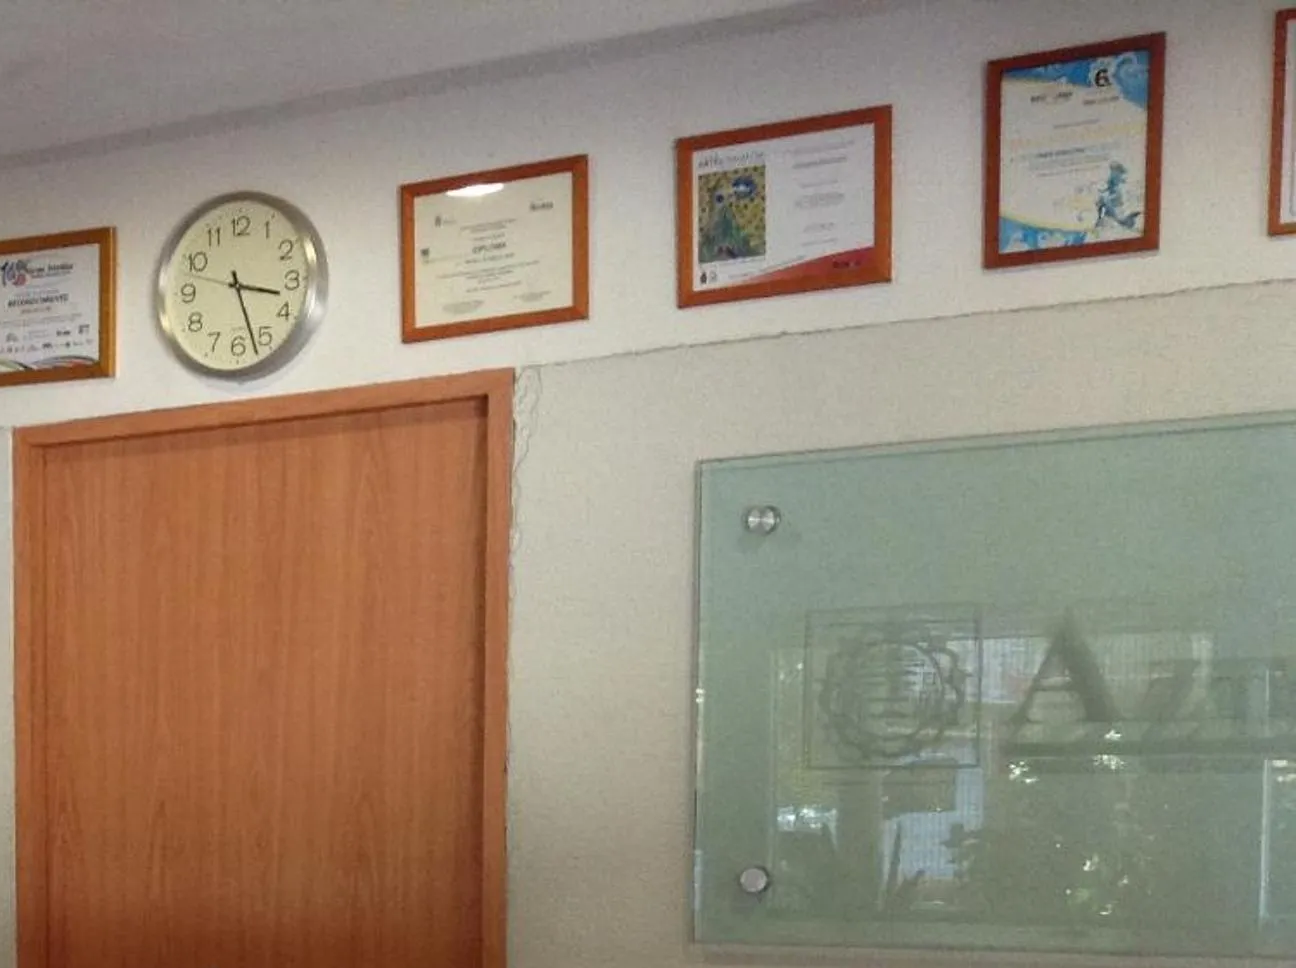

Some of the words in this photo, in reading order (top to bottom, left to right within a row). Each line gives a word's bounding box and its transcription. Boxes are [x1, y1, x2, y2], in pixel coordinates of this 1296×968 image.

[231, 216, 251, 237] 12
[207, 227, 221, 247] 11
[278, 240, 293, 260] 2
[188, 252, 208, 272] 10
[284, 270, 300, 290] 3
[181, 283, 196, 304] 9
[276, 302, 291, 321] 4
[188, 312, 203, 333] 8
[208, 332, 221, 352] 7
[231, 336, 246, 356] 6
[258, 326, 272, 346] 5
